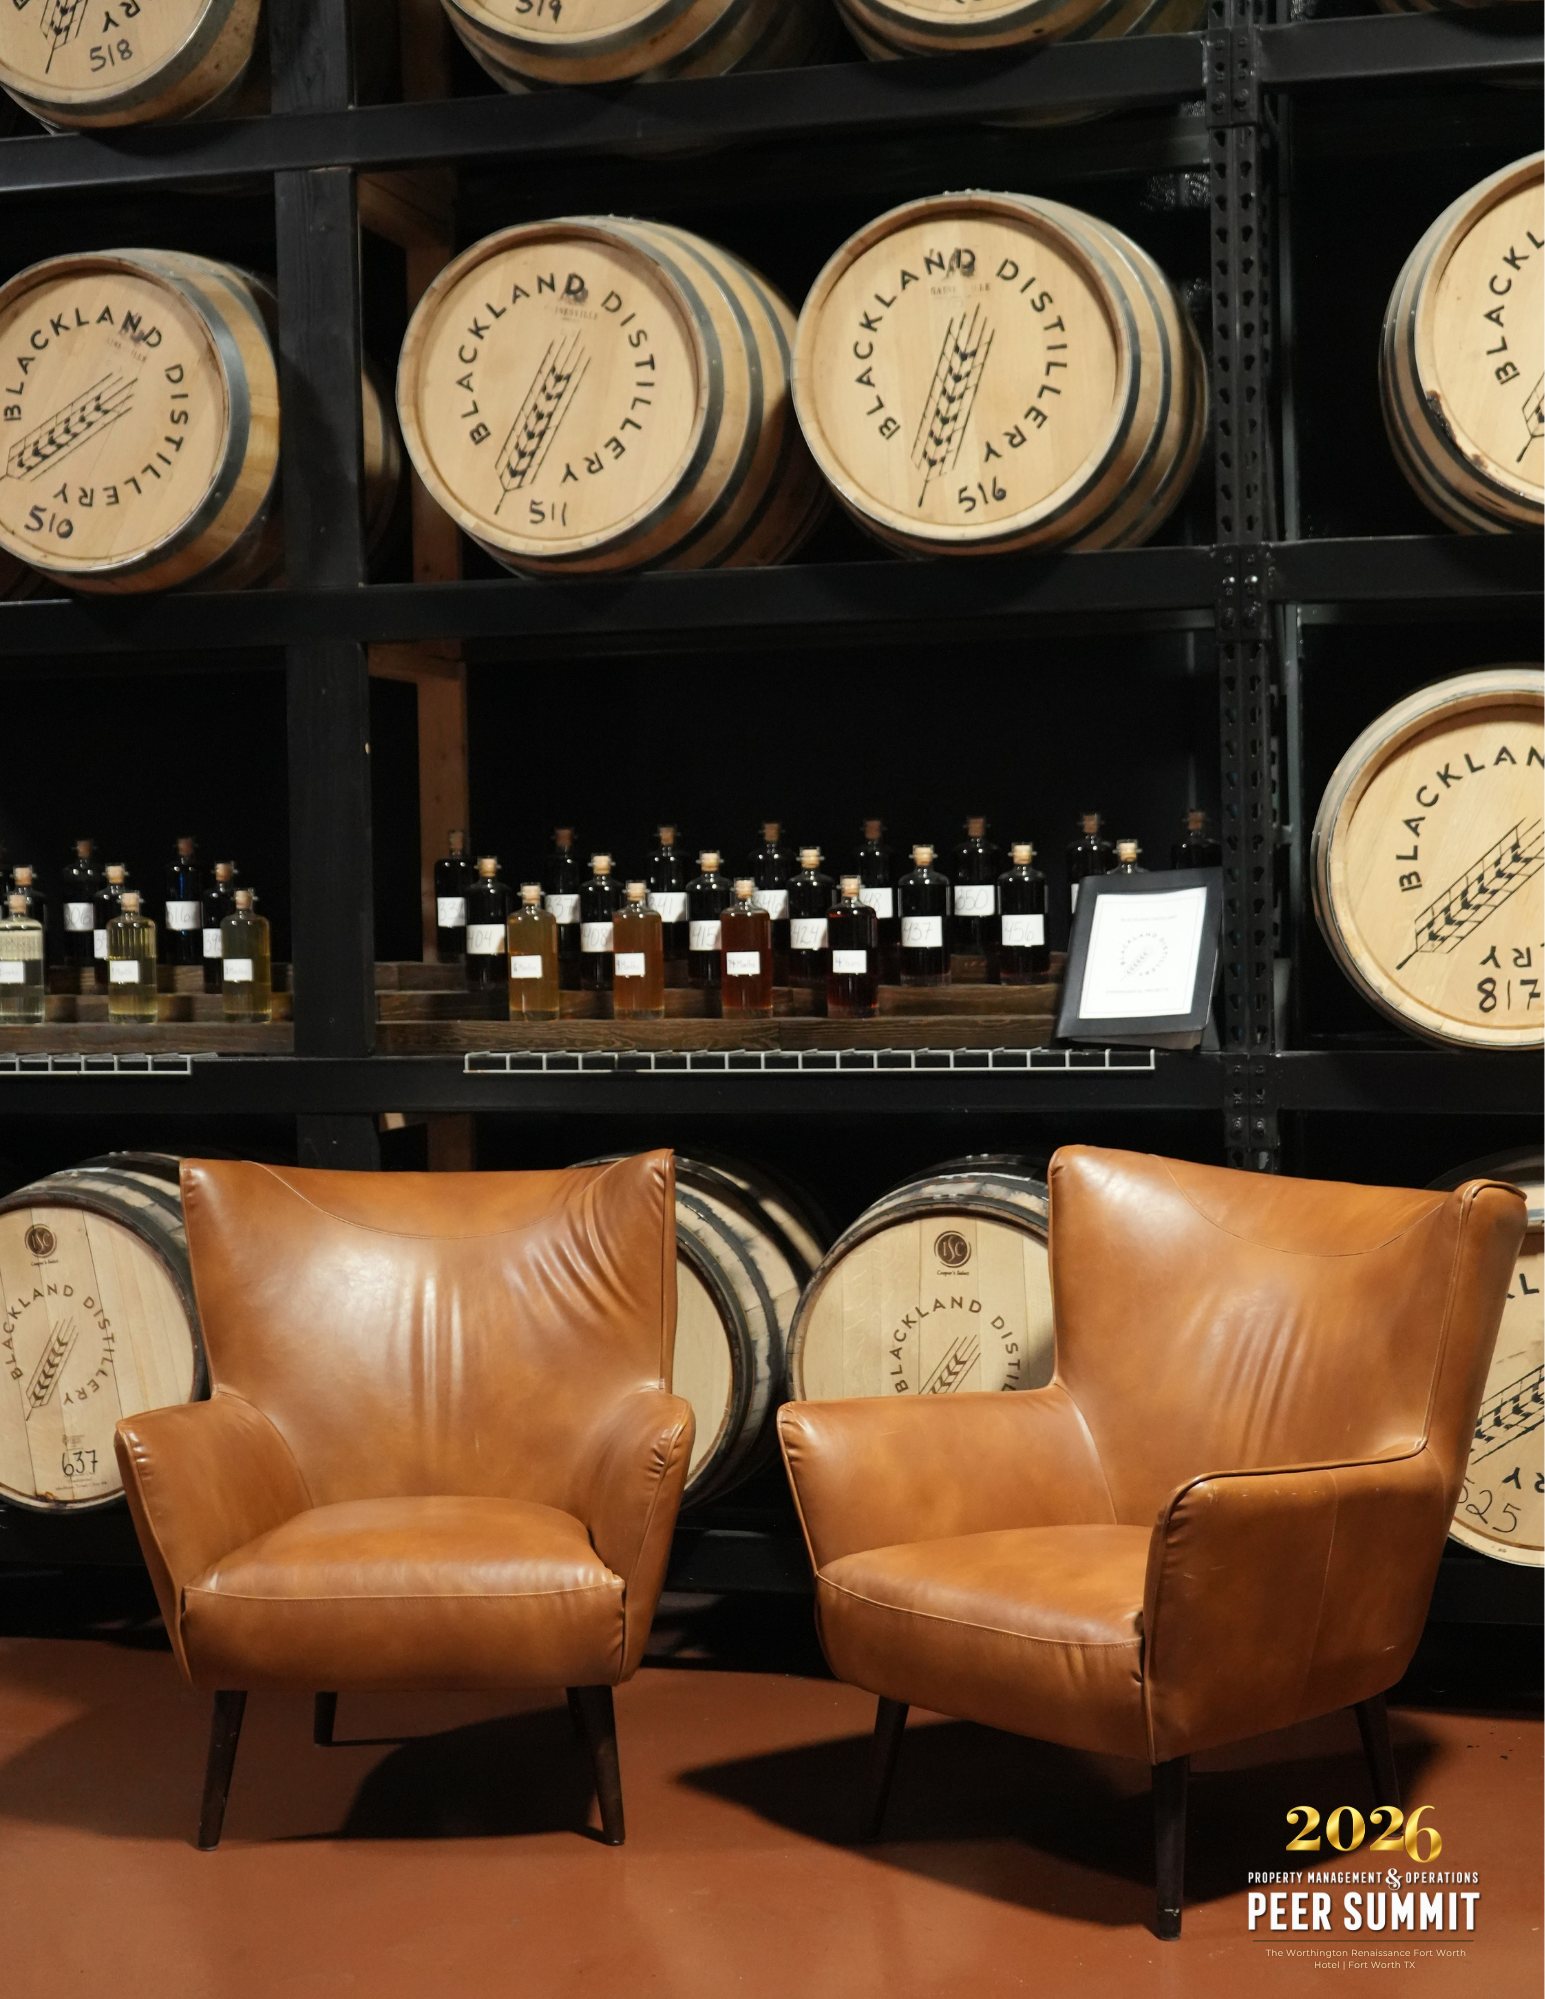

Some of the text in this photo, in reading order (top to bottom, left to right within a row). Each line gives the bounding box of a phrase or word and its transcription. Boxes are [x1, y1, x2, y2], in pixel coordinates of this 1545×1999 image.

[89, 39, 134, 72] 518
[852, 248, 1069, 463] BLACKLAND DISTILLERY
[455, 272, 656, 484] BLACKLAND DISTILLERY
[3, 304, 189, 508] BLACKLAND DISTILLERY
[528, 499, 568, 527] 511
[957, 475, 1008, 514] 516
[23, 504, 74, 540] 510
[1476, 976, 1542, 1013] 817
[1, 1283, 116, 1406] BLACKLAND DISTILLERY
[889, 1295, 1021, 1394] BLACKLAND DISTIL
[61, 1448, 99, 1477] 637
